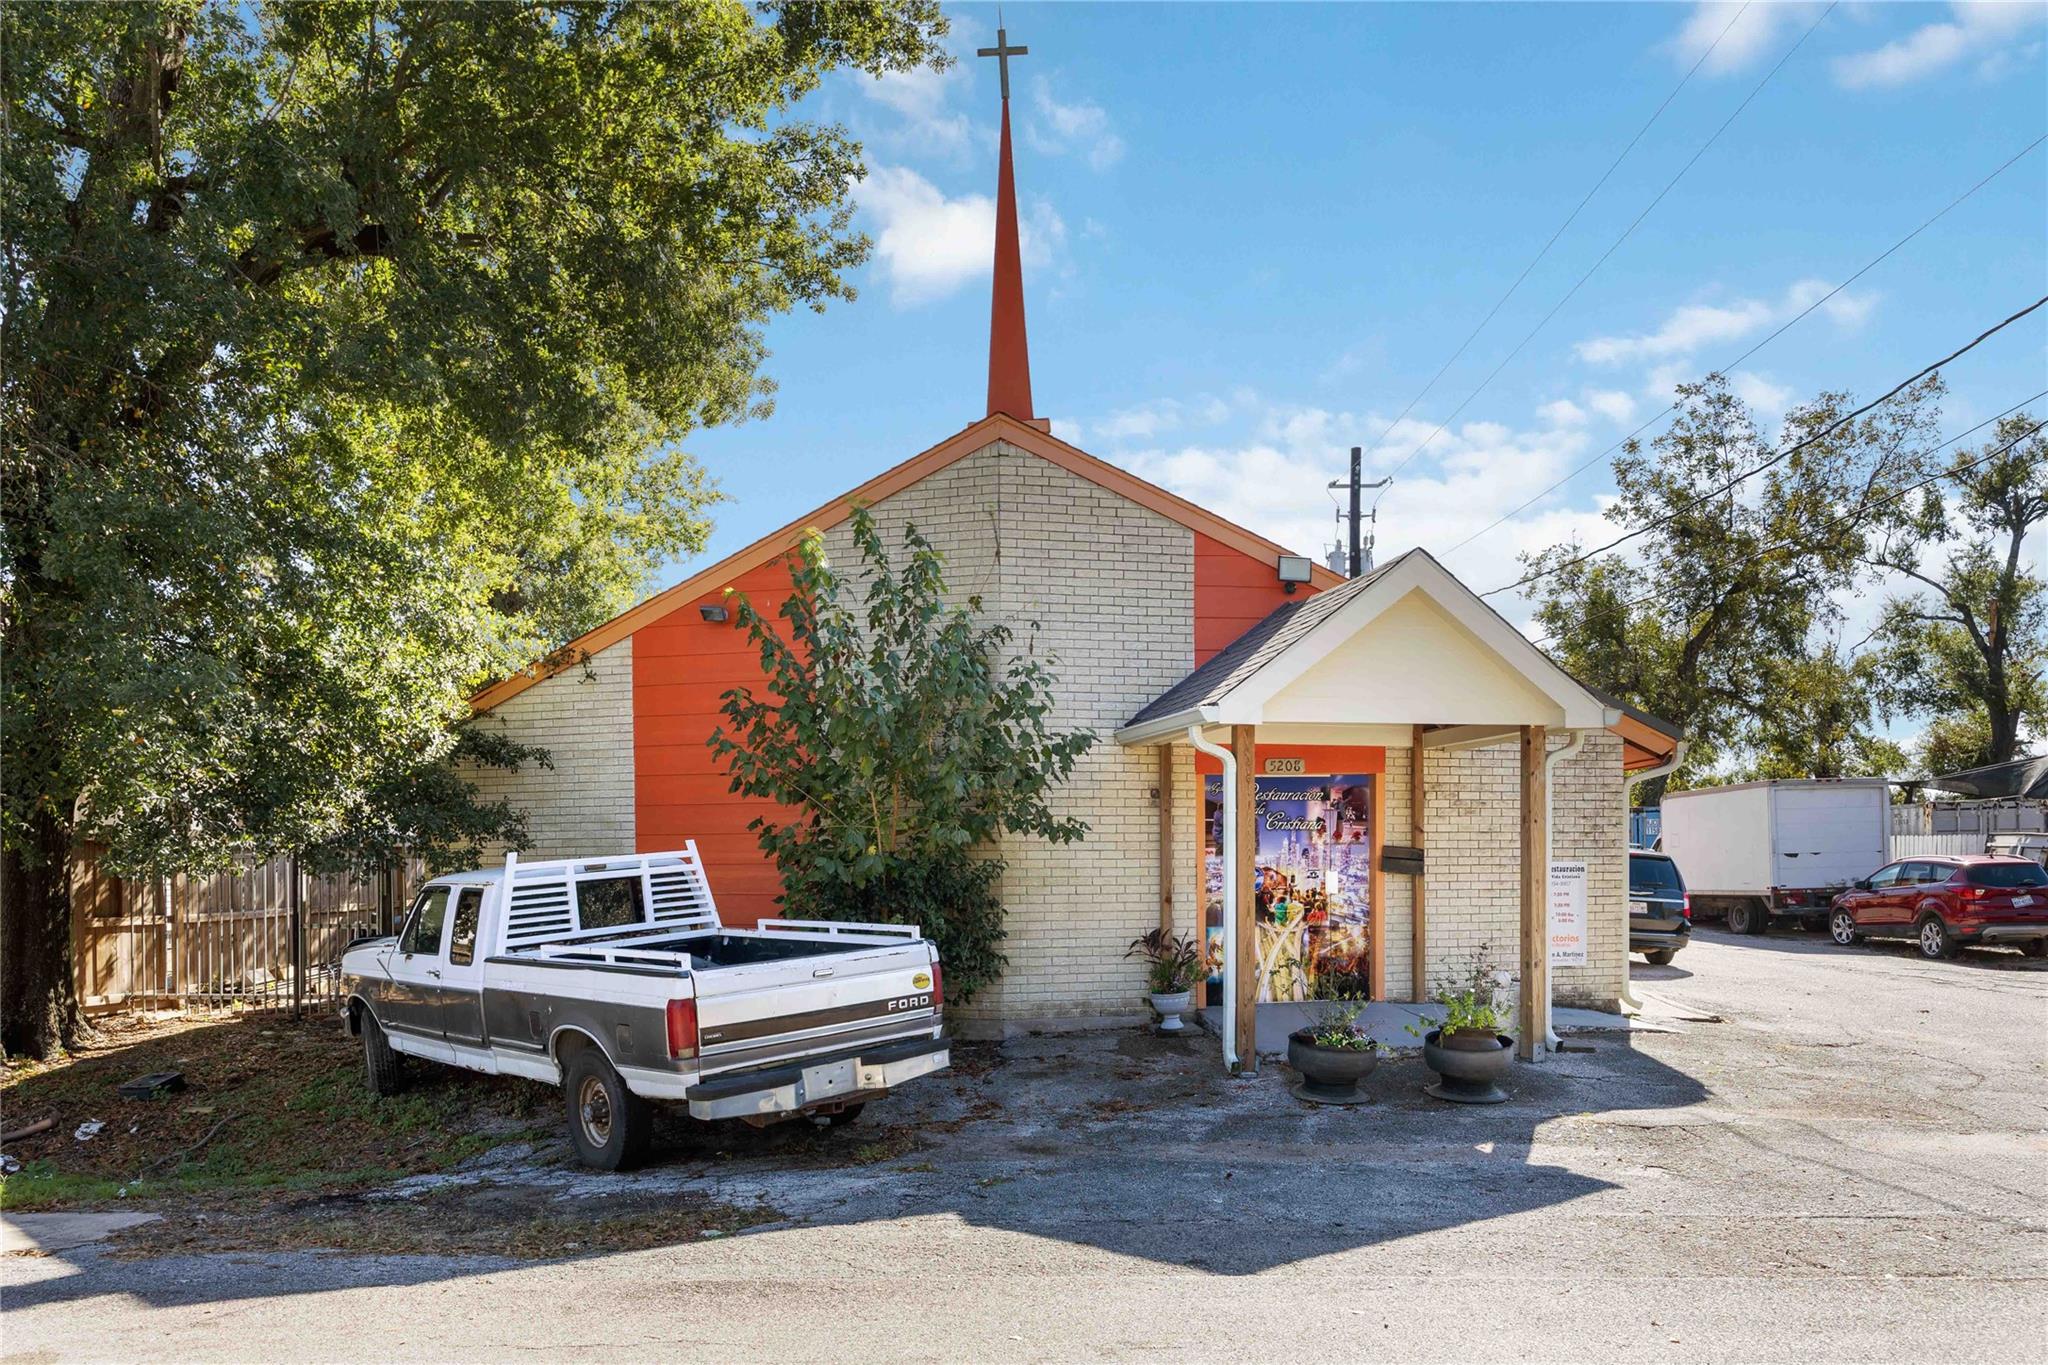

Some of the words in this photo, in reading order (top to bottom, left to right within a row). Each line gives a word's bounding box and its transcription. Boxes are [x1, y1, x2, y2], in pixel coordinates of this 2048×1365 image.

[1269, 760, 1301, 772] 5208
[1266, 812, 1323, 831] Cristiana
[1552, 934, 1580, 942] ctorias
[888, 995, 929, 1011] FORD
